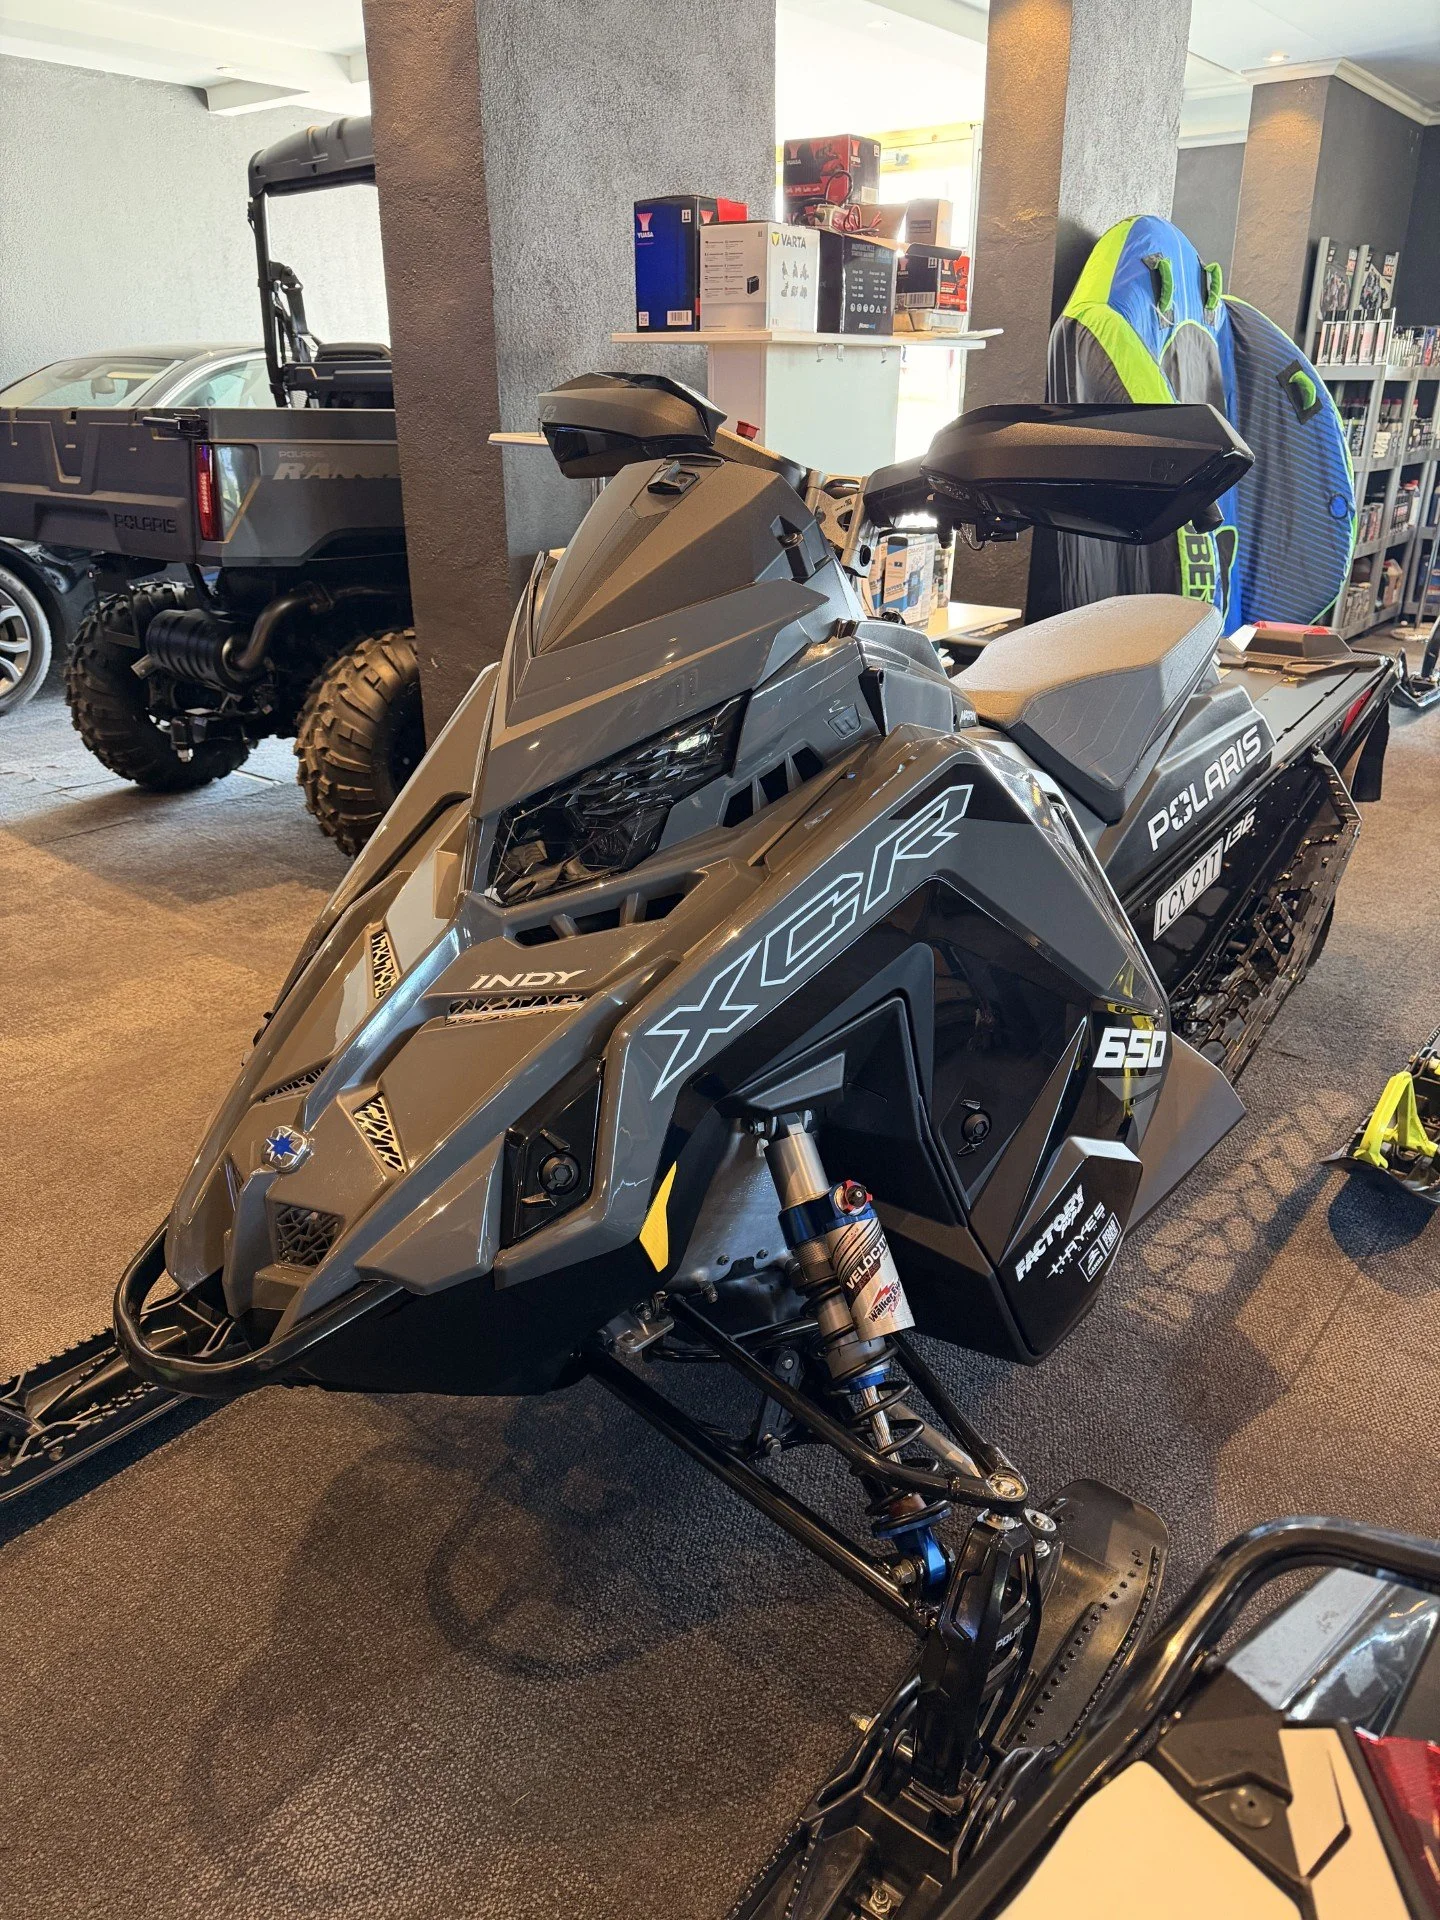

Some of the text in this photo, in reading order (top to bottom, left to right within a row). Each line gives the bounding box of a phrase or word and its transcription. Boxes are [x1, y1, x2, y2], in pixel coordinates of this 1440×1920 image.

[781, 233, 807, 250] VARTA
[113, 513, 177, 534] POLARIS
[1147, 724, 1262, 851] POLARIS
[1224, 807, 1257, 854] 136
[1158, 848, 1219, 932] LCX 91T
[644, 783, 974, 1101] XCR
[468, 969, 587, 990] INDY
[1092, 1027, 1167, 1069] 650
[1014, 1184, 1084, 1282] FACTORY
[1046, 1201, 1105, 1279] HAYES
